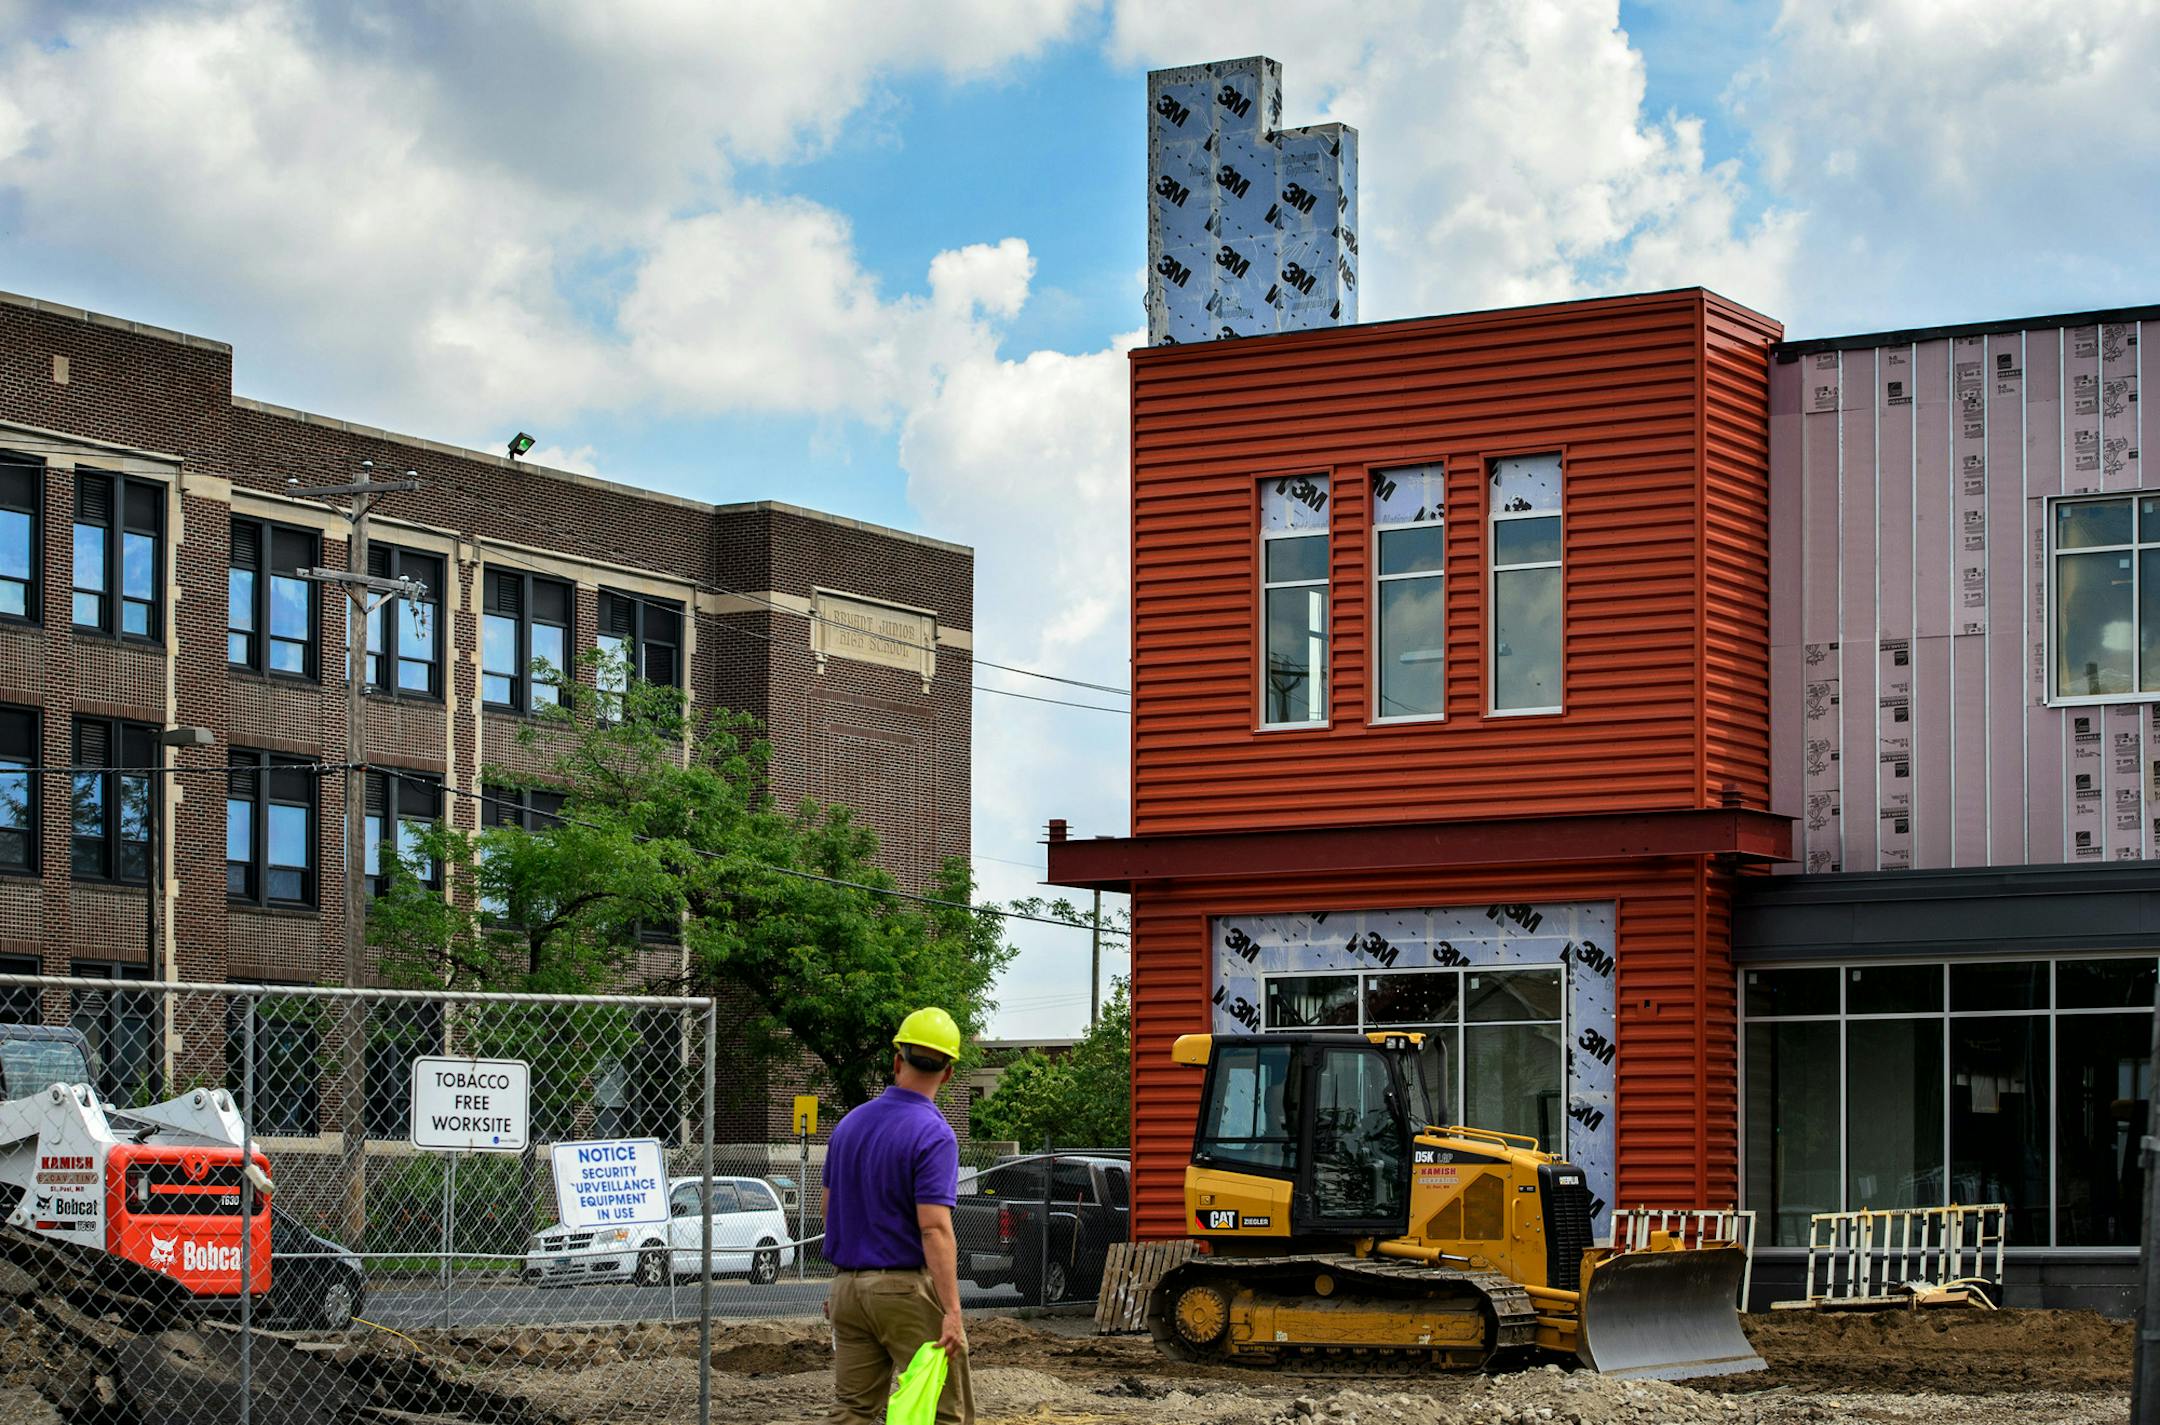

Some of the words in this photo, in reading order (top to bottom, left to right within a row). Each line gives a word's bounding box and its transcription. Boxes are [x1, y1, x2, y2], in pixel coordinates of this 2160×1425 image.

[1156, 95, 1190, 128] 3M
[1217, 85, 1251, 119] 3M
[1155, 175, 1190, 208] 3M
[1216, 165, 1251, 199] 3M
[1282, 183, 1317, 215] 3M
[1156, 255, 1192, 288] 3M
[1216, 246, 1251, 279] 3M
[1281, 262, 1317, 295] 3M
[1291, 478, 1328, 513] 3M
[839, 630, 864, 649] HIGH
[869, 639, 909, 657] SCHOOL
[879, 620, 915, 641] JUNIOR
[1504, 904, 1543, 934] 3M
[1225, 928, 1261, 964] 3M
[1362, 931, 1400, 968] 3M
[1433, 941, 1471, 967] 3M
[1576, 940, 1614, 978] 3M
[1229, 996, 1260, 1033] 3M
[1578, 1028, 1616, 1066] 3M
[435, 1072, 510, 1090] TOBACCO
[455, 1095, 490, 1110] FREE
[432, 1115, 512, 1133] WORKSITE
[41, 1156, 93, 1169] KAMISH
[578, 1146, 636, 1164] NOTICE
[1414, 1151, 1434, 1163] D5K
[582, 1166, 637, 1179] SECURITY
[1421, 1167, 1456, 1175] KAMISH
[571, 1179, 656, 1195] URVEILLANCE
[56, 1198, 98, 1216] Bobcat
[220, 1195, 240, 1206] T630
[580, 1193, 647, 1208] EQUIPMENT
[597, 1209, 610, 1220] IN
[614, 1207, 635, 1219] USE
[1210, 1210, 1235, 1229] CAT
[1243, 1217, 1269, 1226] ZIEGLER
[183, 1240, 250, 1272] Bobca
